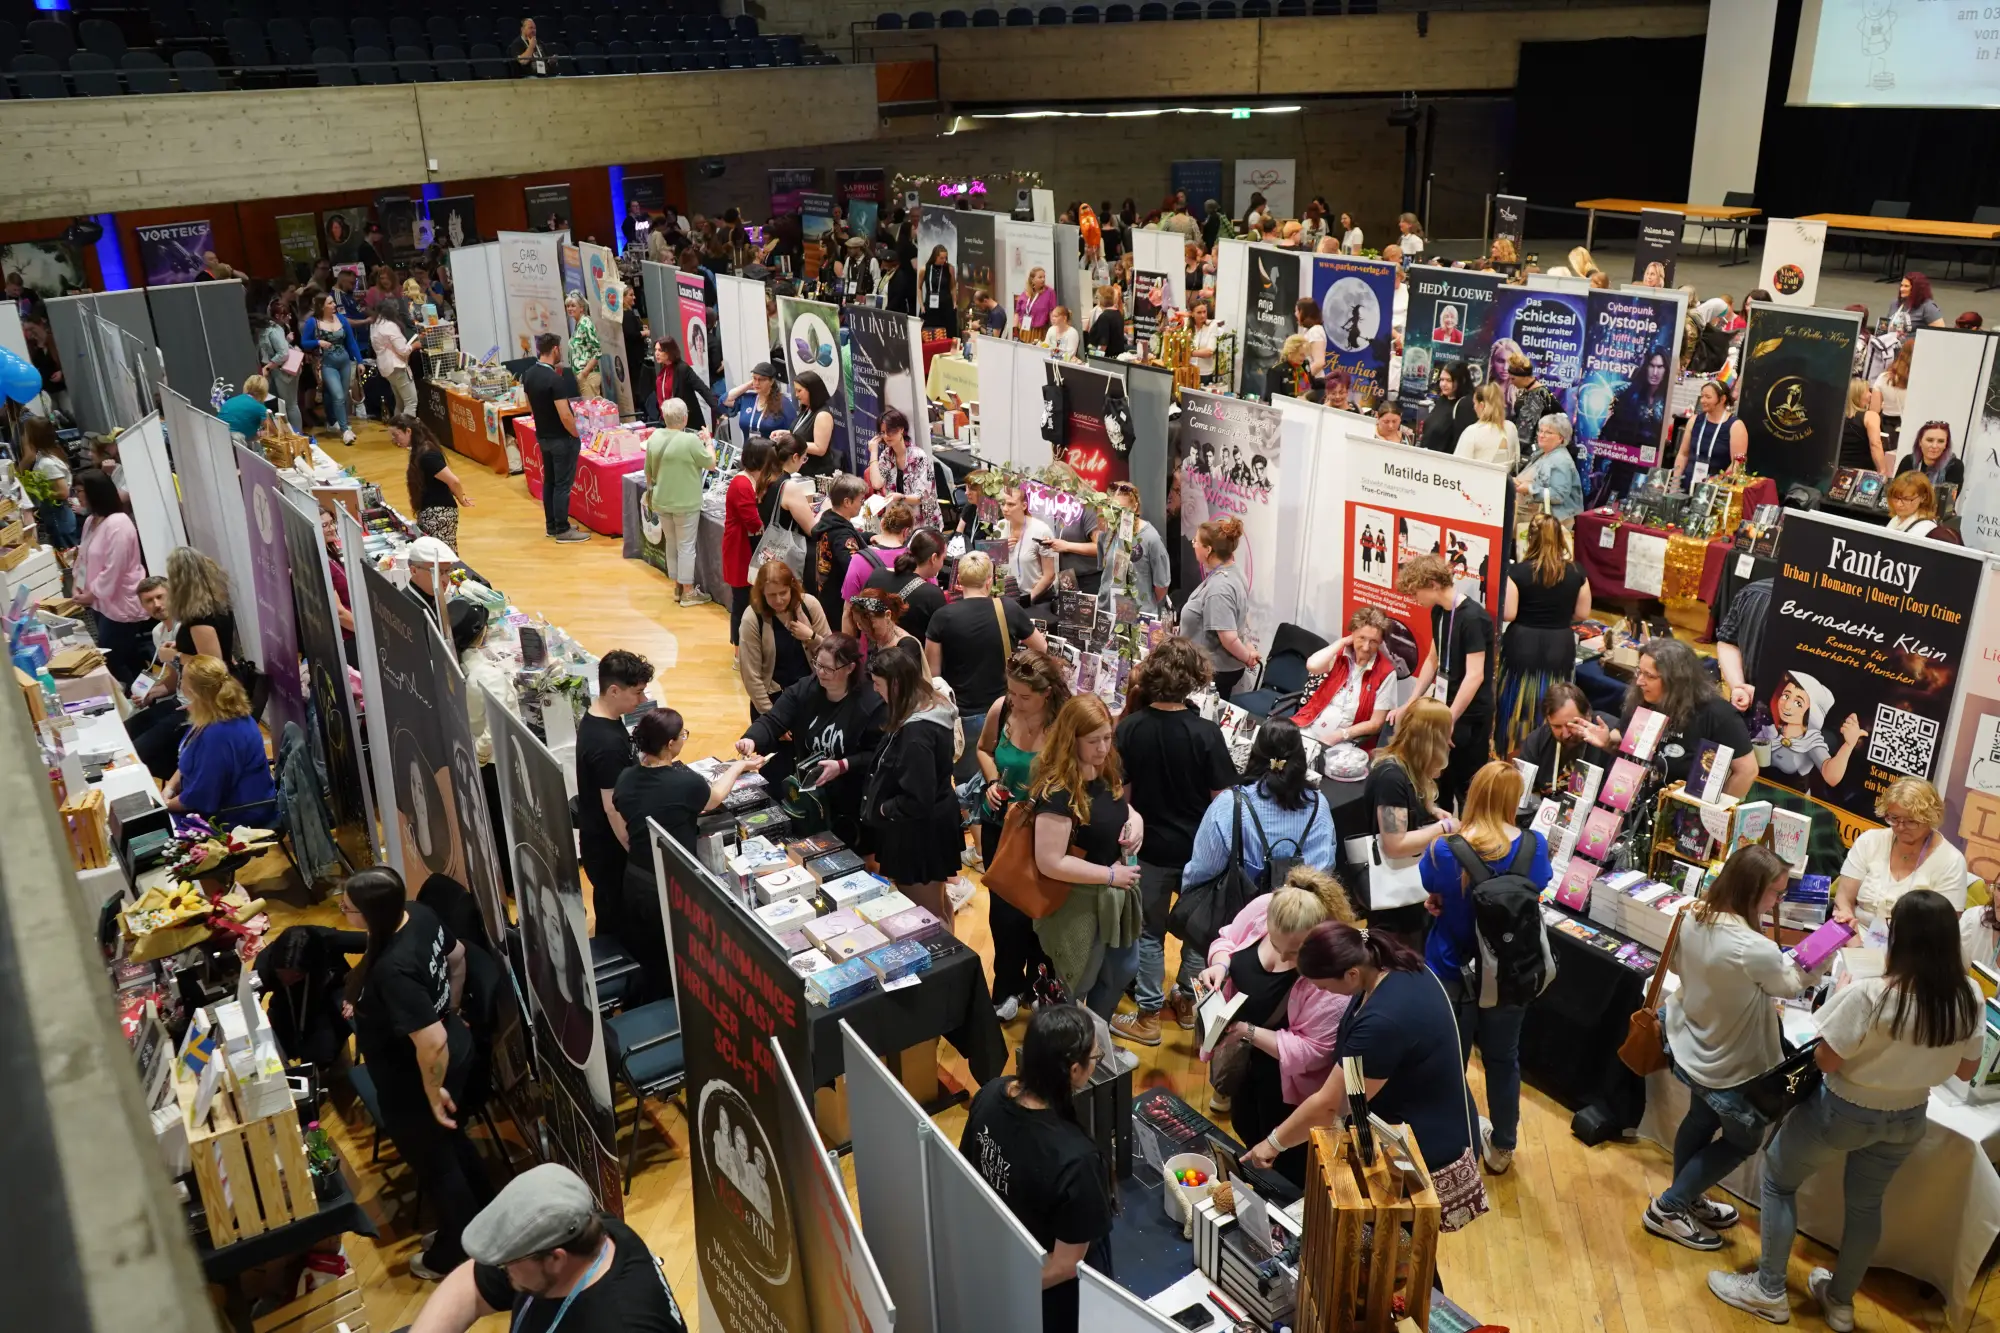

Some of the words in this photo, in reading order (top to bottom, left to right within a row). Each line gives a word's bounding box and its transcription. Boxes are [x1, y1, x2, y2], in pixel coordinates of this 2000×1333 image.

[1957, 9, 1979, 21] am
[1974, 28, 1999, 40] von
[1976, 46, 1990, 60] in
[843, 182, 879, 193] SAPPHIC
[511, 262, 548, 275] SCHMID
[1319, 260, 1390, 276] www.parker-verlag.de
[1418, 282, 1451, 297] HEDY
[1452, 286, 1494, 302] LOEWE
[1526, 297, 1542, 307] Das
[1607, 301, 1654, 317] Cyberpunk
[1515, 308, 1577, 326] Schicksal
[1522, 325, 1546, 334] zweier
[1547, 326, 1573, 337] uralter
[1522, 334, 1577, 352] Blutlinien
[1545, 351, 1580, 364] Raum
[1550, 363, 1577, 378] Zeit
[1587, 355, 1638, 379] Fantasy
[1537, 377, 1573, 389] rbunden
[1187, 400, 1213, 416] Dunkle
[1189, 416, 1209, 430] Come
[1209, 423, 1217, 433] in
[1217, 427, 1230, 436] and
[1067, 448, 1108, 472] Ride
[1593, 446, 1639, 465] 2044serie.de
[1384, 462, 1430, 484] Matilda
[1201, 484, 1248, 513] WORLD
[1361, 485, 1398, 500] True-Crimes
[1976, 513, 2000, 527] PAR
[1828, 537, 1922, 594] Fantasy
[1783, 563, 1811, 584] Urban
[1821, 573, 1863, 598] Romance
[1871, 587, 1899, 608] Queer
[1906, 597, 1930, 618] Cosy
[1931, 603, 1962, 625] Crime
[1779, 599, 1885, 644] Bernadette
[1893, 633, 1947, 662] Klein
[1825, 635, 1867, 656] Romane
[1795, 642, 1860, 668] zauberhafte
[1863, 661, 1916, 686] Menschen
[1870, 765, 1888, 780] Scan
[1864, 779, 1876, 792] ein
[669, 875, 717, 950] (DARK)
[721, 929, 796, 1029] ROMANCE
[688, 932, 775, 1038] ROMANTASY
[675, 952, 740, 1040] THRILLER
[714, 1026, 759, 1095] SCI-FI
[706, 1246, 753, 1312] Leseseele
[713, 1236, 731, 1269] Wir
[733, 1261, 769, 1317] küssen
[716, 1274, 736, 1309] jede
